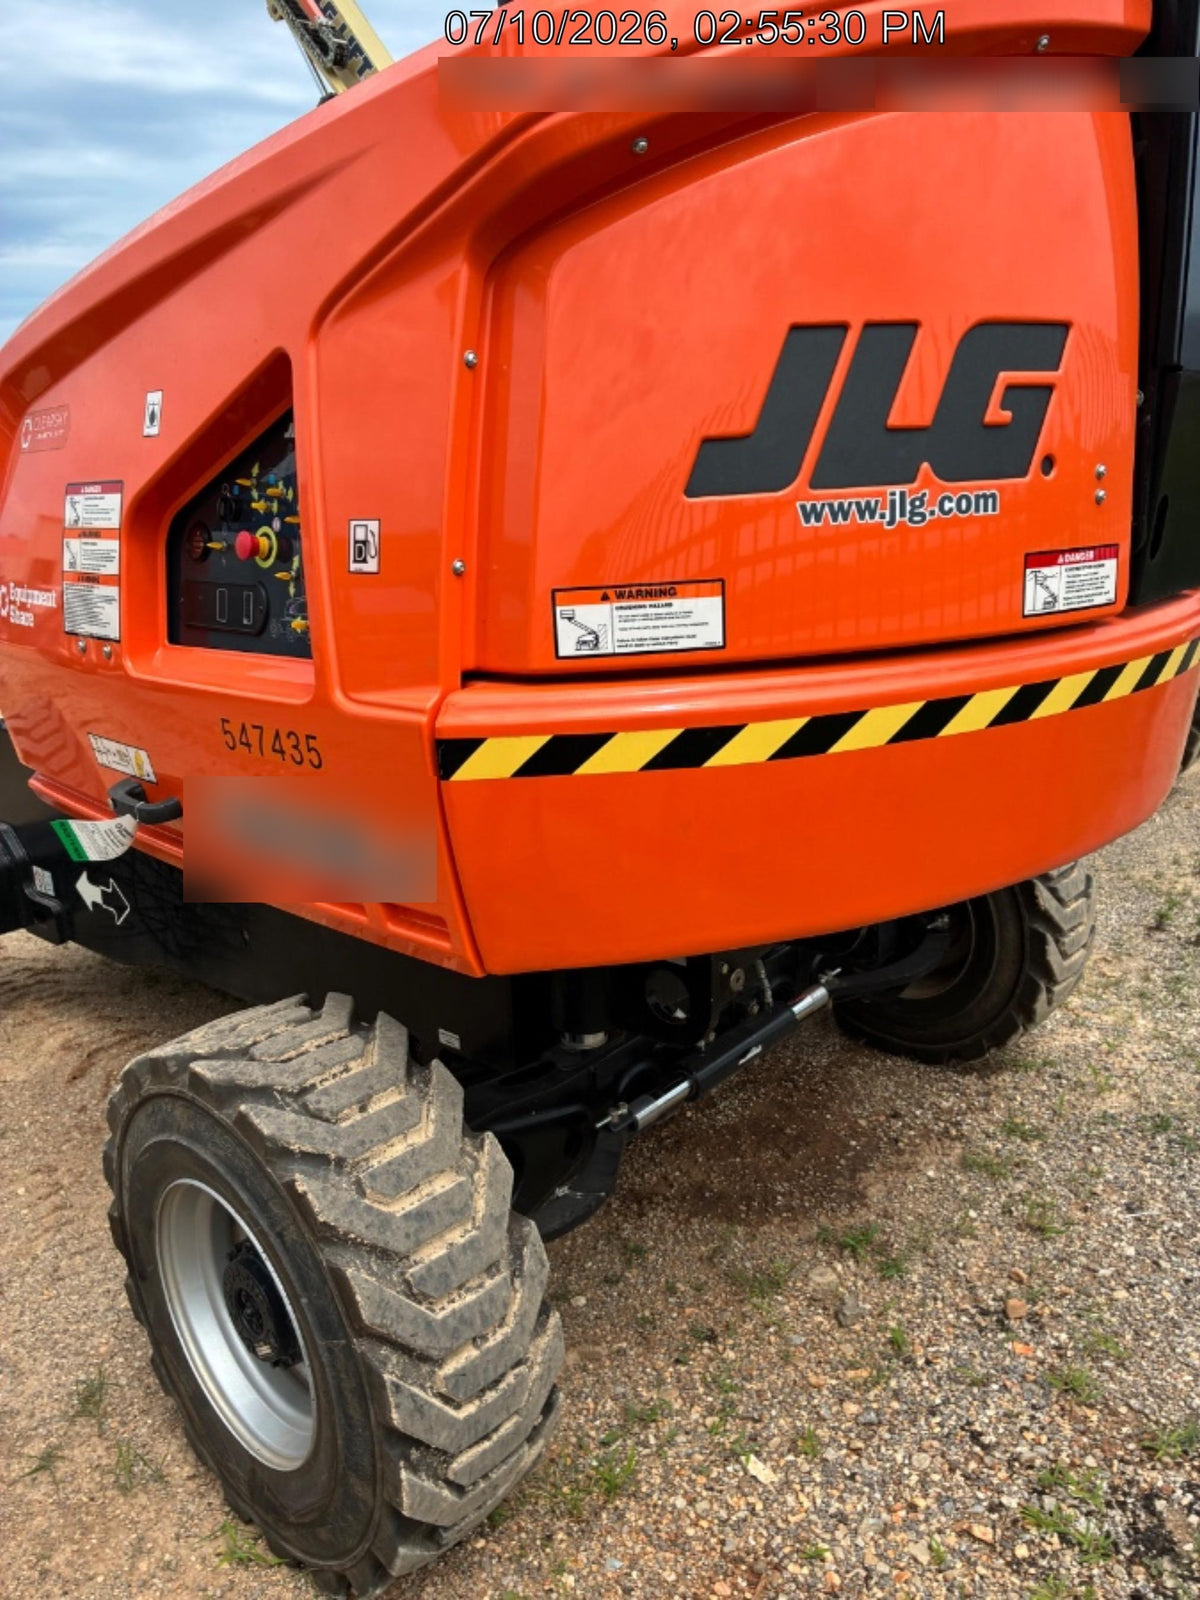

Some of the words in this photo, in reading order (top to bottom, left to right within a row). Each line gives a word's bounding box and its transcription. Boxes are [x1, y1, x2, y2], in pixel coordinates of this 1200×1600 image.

[685, 321, 1071, 498] JLG
[798, 490, 1000, 528] www.jlg.com
[1064, 551, 1094, 563] DANGER
[9, 582, 57, 609] Equipment
[614, 587, 677, 599] WARNING
[9, 604, 35, 628] Share
[220, 718, 323, 769] 547435
